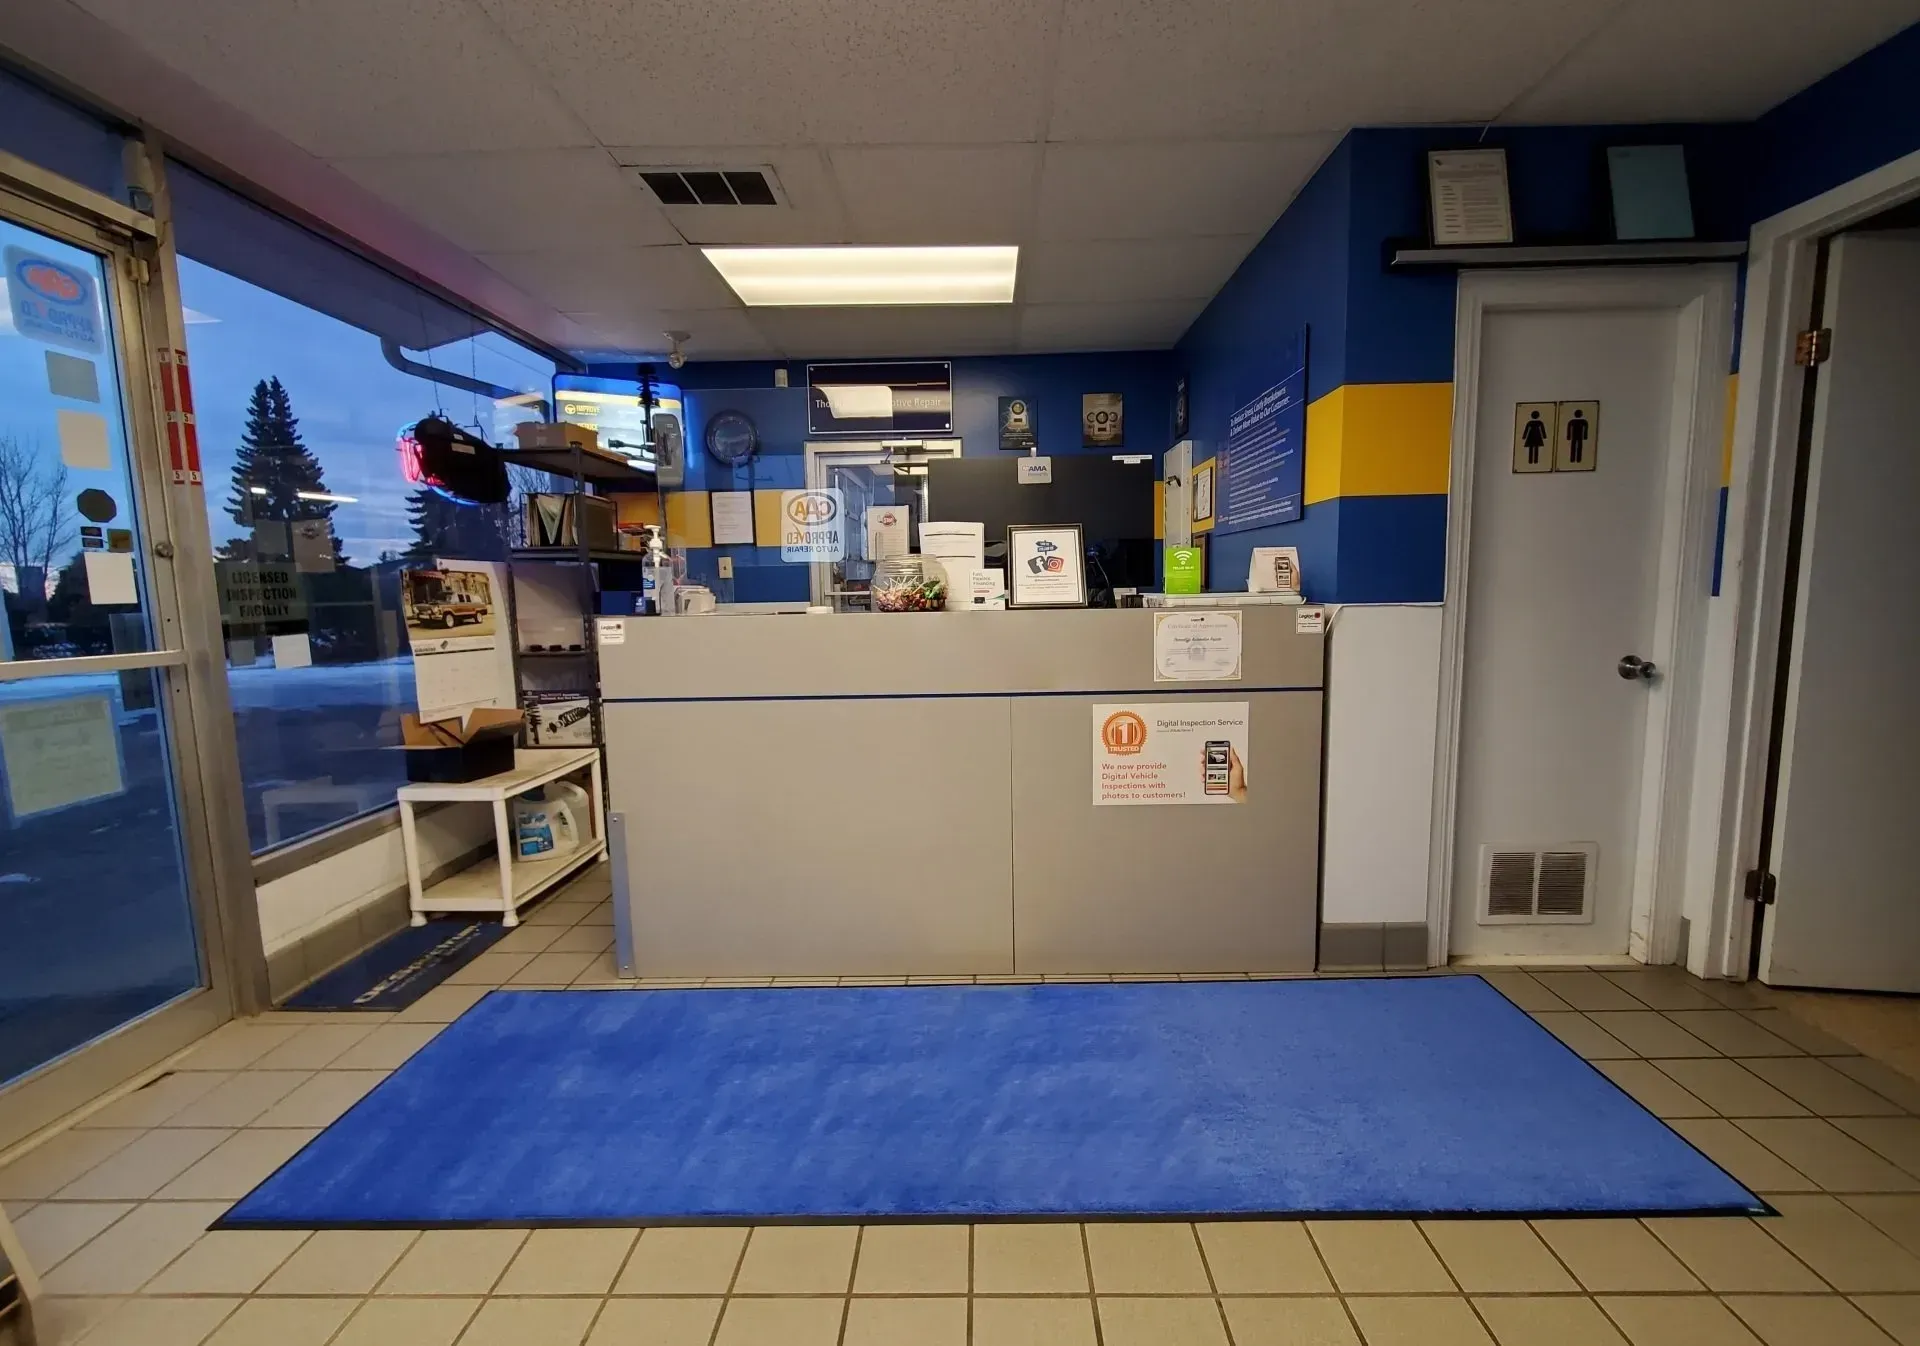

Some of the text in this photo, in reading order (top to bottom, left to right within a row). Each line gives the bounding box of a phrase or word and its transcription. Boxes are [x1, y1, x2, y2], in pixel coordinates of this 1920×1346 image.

[914, 397, 940, 410] Repair
[184, 413, 189, 423] 5
[175, 471, 180, 480] 5
[192, 472, 197, 480] 5
[231, 571, 288, 585] LICENSED
[226, 587, 297, 602] INSPECTION
[239, 604, 289, 617] FACILITY
[1157, 719, 1178, 728] Digital
[1180, 719, 1215, 728] Inspection
[1136, 763, 1167, 771] provide
[1102, 773, 1128, 781] Digital
[1102, 792, 1129, 800] photos
